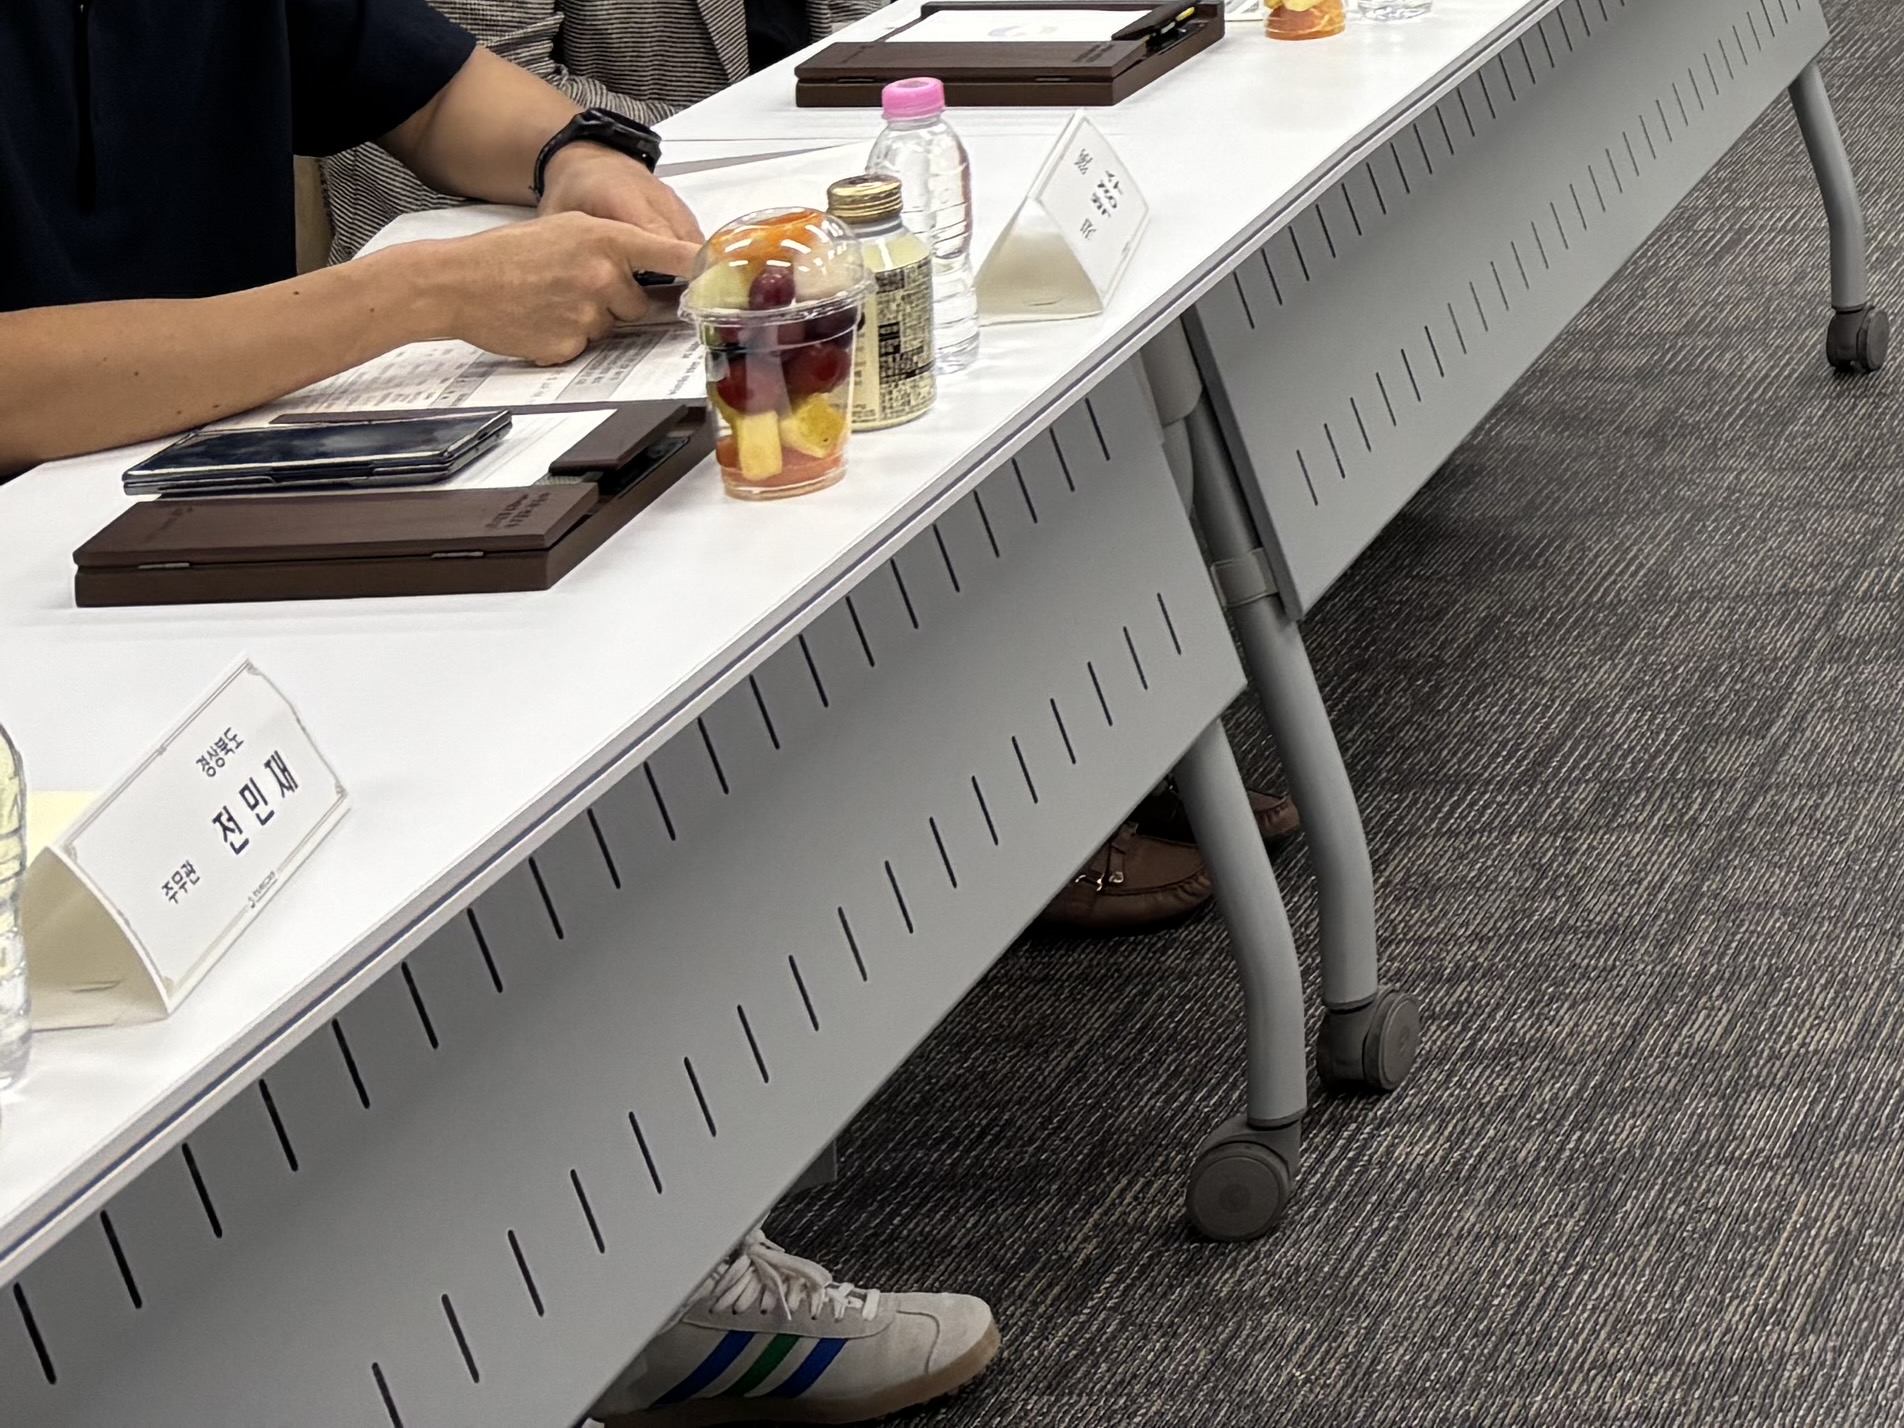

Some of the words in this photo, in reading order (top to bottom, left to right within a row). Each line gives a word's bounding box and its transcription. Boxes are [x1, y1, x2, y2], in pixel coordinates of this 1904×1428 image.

[196, 727, 244, 778] 경상북도
[211, 750, 299, 855] 전민재
[161, 859, 201, 904] 주무관
